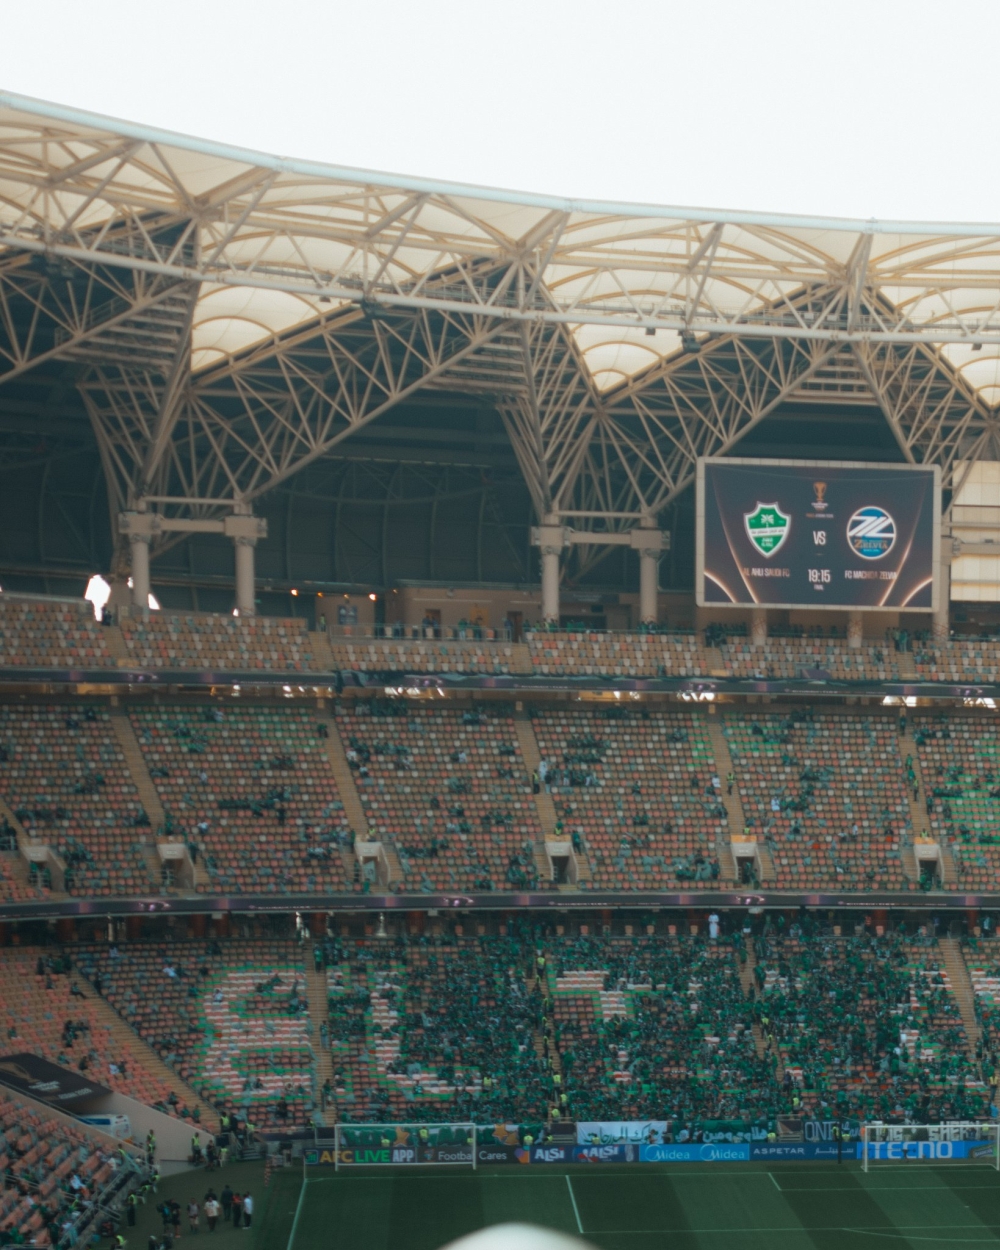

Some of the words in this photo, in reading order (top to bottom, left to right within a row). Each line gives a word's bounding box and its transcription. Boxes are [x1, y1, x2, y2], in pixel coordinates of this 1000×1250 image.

[813, 530, 826, 546] VS
[808, 569, 831, 583] 19:15
[845, 570, 853, 579] FC
[320, 1150, 353, 1163] AFC
[354, 1149, 390, 1163] LIVE
[393, 1148, 415, 1163] APP
[439, 1151, 476, 1161] Footba
[478, 1151, 507, 1161] Cares
[655, 1149, 690, 1160] Midea
[709, 1149, 745, 1159] Midea
[868, 1142, 953, 1159] TECNO
